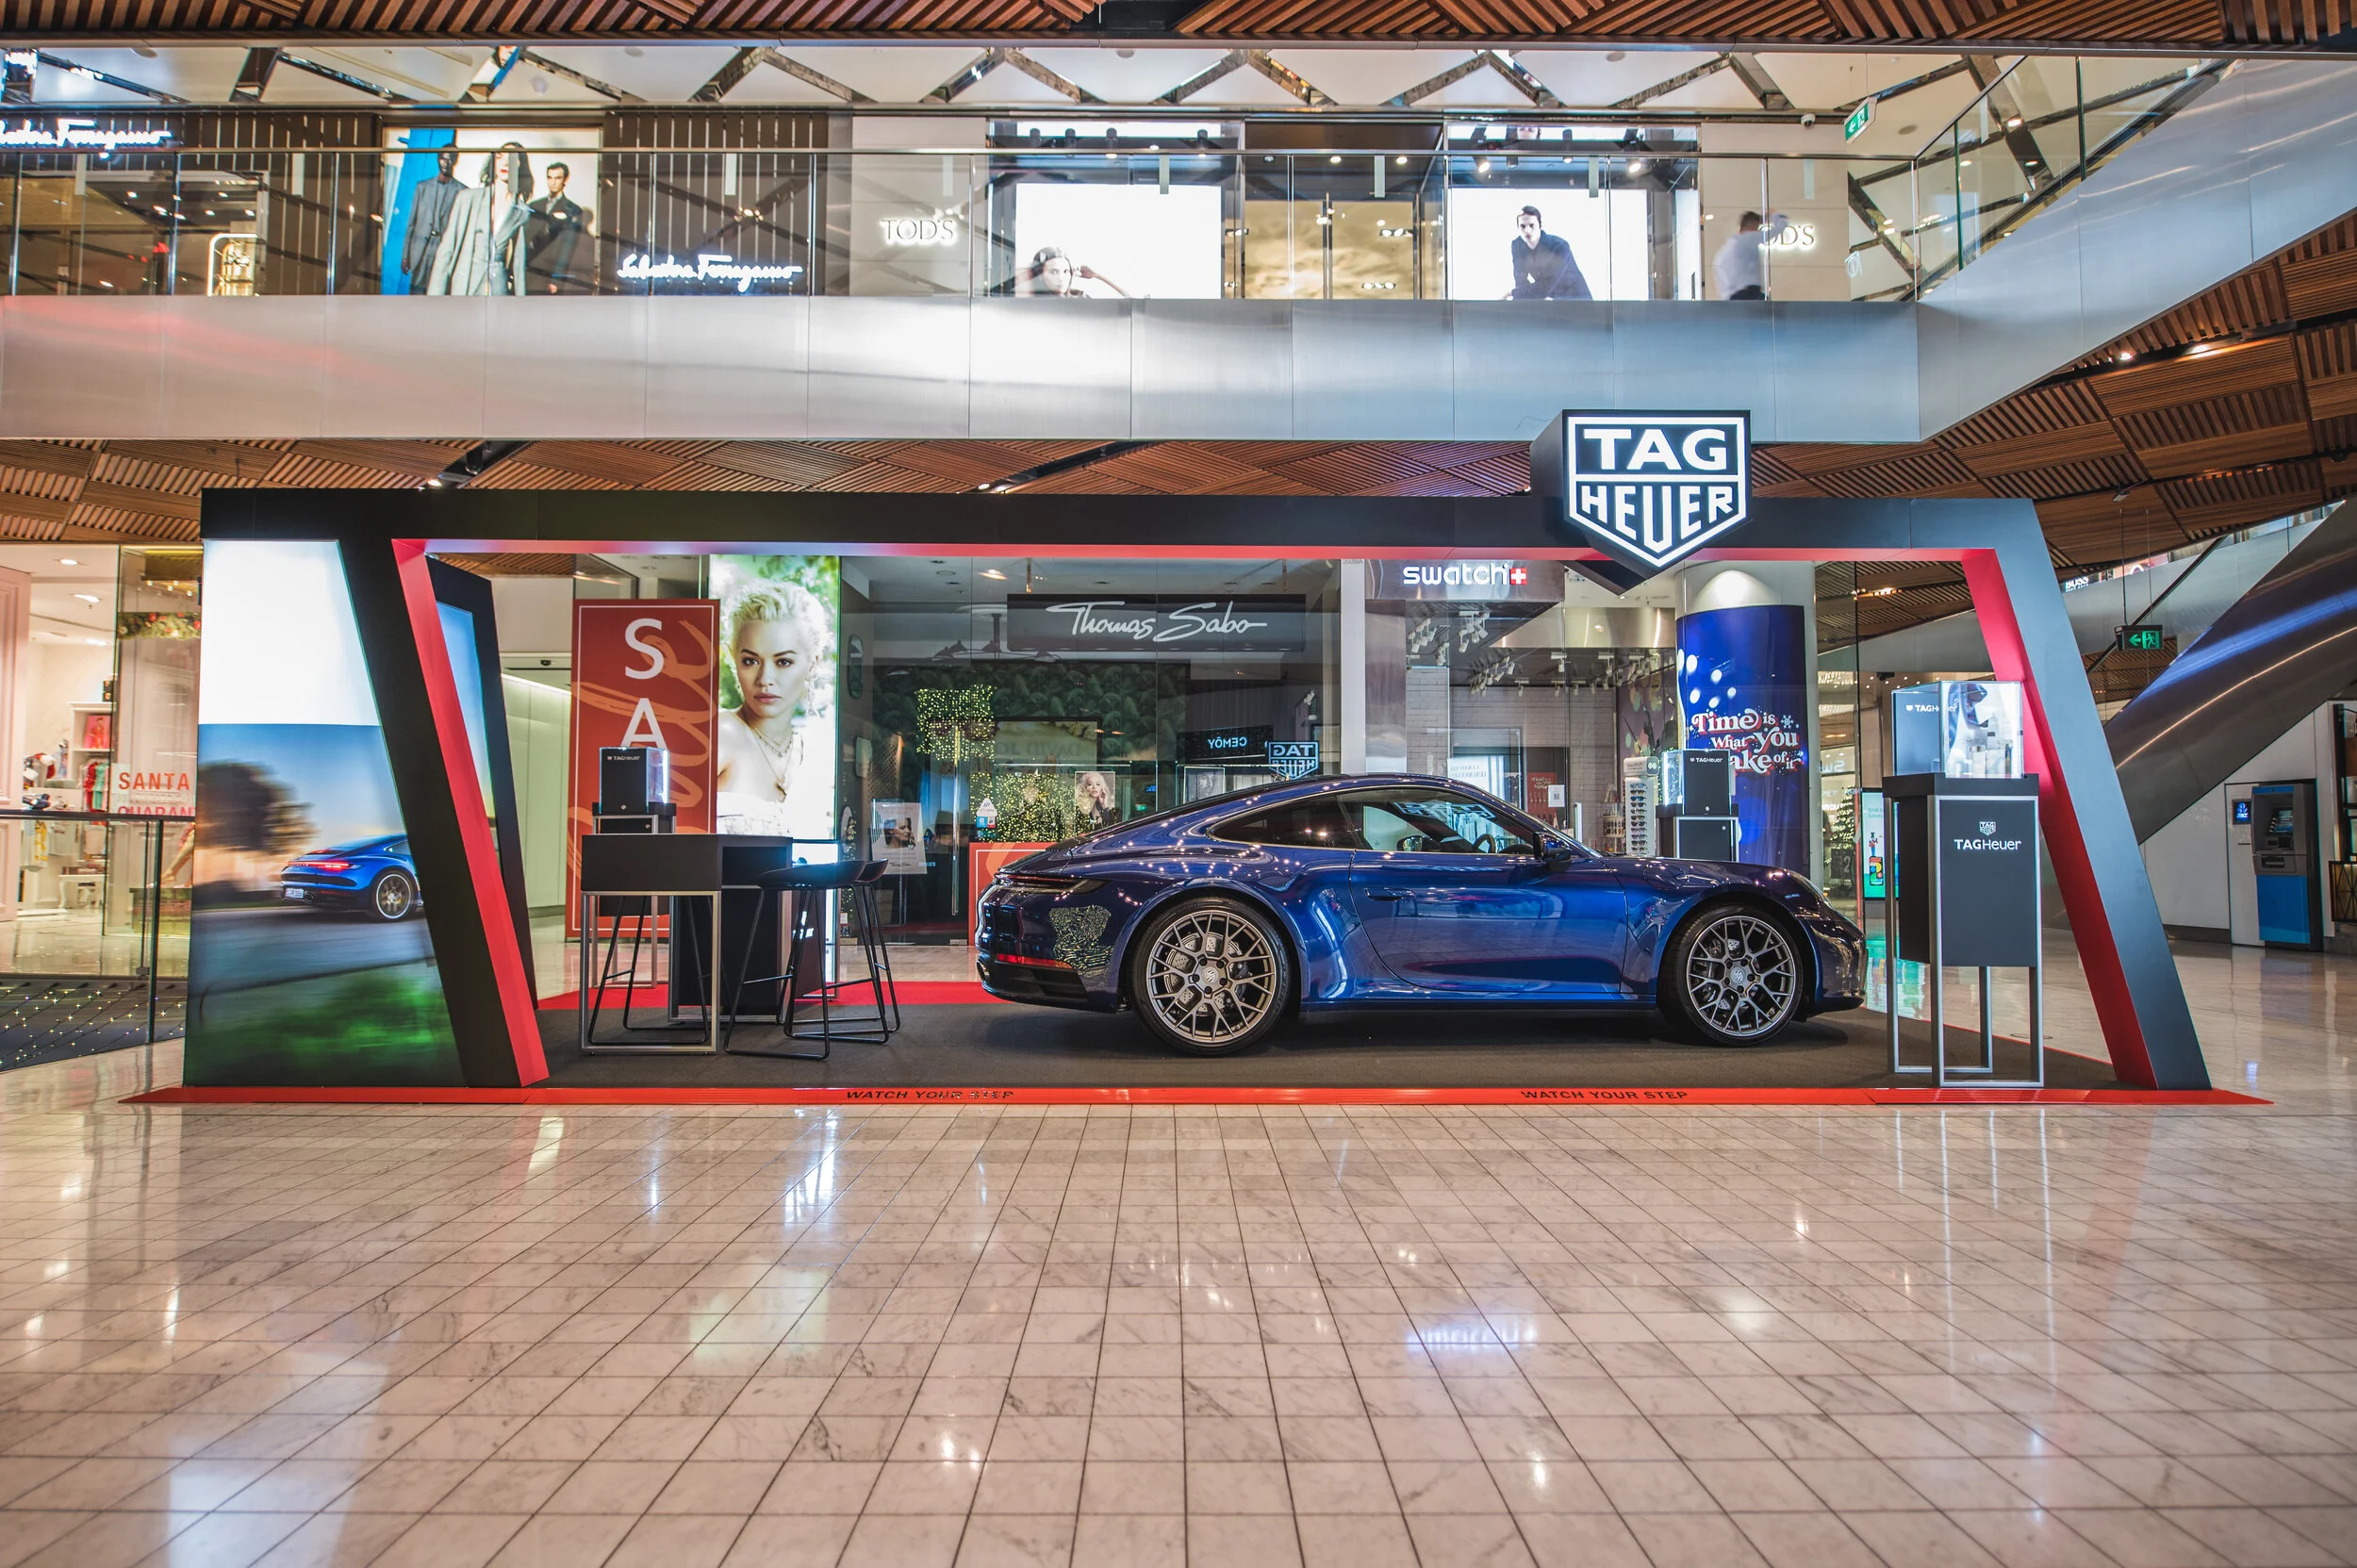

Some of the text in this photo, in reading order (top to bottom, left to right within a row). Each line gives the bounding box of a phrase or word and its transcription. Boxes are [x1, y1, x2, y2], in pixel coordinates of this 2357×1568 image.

[882, 219, 954, 240] TOD'S
[1584, 429, 1726, 470] TAG
[1581, 486, 1734, 553] HEUER
[1403, 563, 1508, 585] swatch
[1046, 601, 1268, 642] Thomas Sabo
[1691, 708, 1776, 733] Time is
[1711, 734, 1755, 751] What
[1730, 750, 1802, 773] ake of it
[118, 771, 190, 790] SANTA
[1953, 839, 2022, 850] TAGHeuer
[846, 1091, 1014, 1099] WATCH YOUR STEP
[1521, 1091, 1689, 1099] WATCH YOUR STEP
